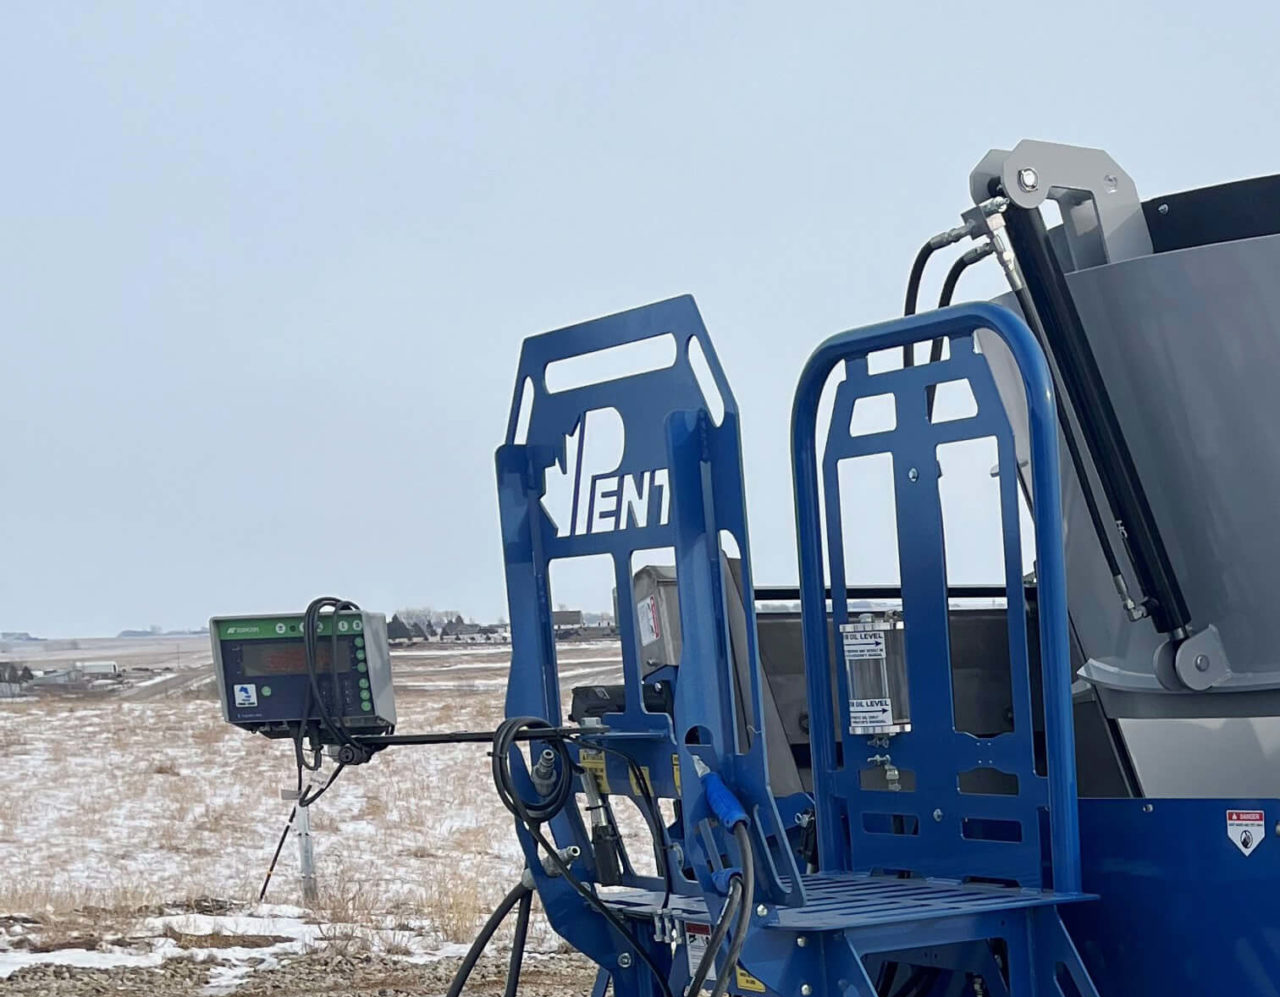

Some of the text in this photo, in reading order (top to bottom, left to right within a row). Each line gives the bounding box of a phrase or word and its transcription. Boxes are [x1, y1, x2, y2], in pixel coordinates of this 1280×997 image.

[574, 406, 671, 537] PENT
[859, 631, 883, 640] LEVEL
[866, 699, 889, 707] LEVEL
